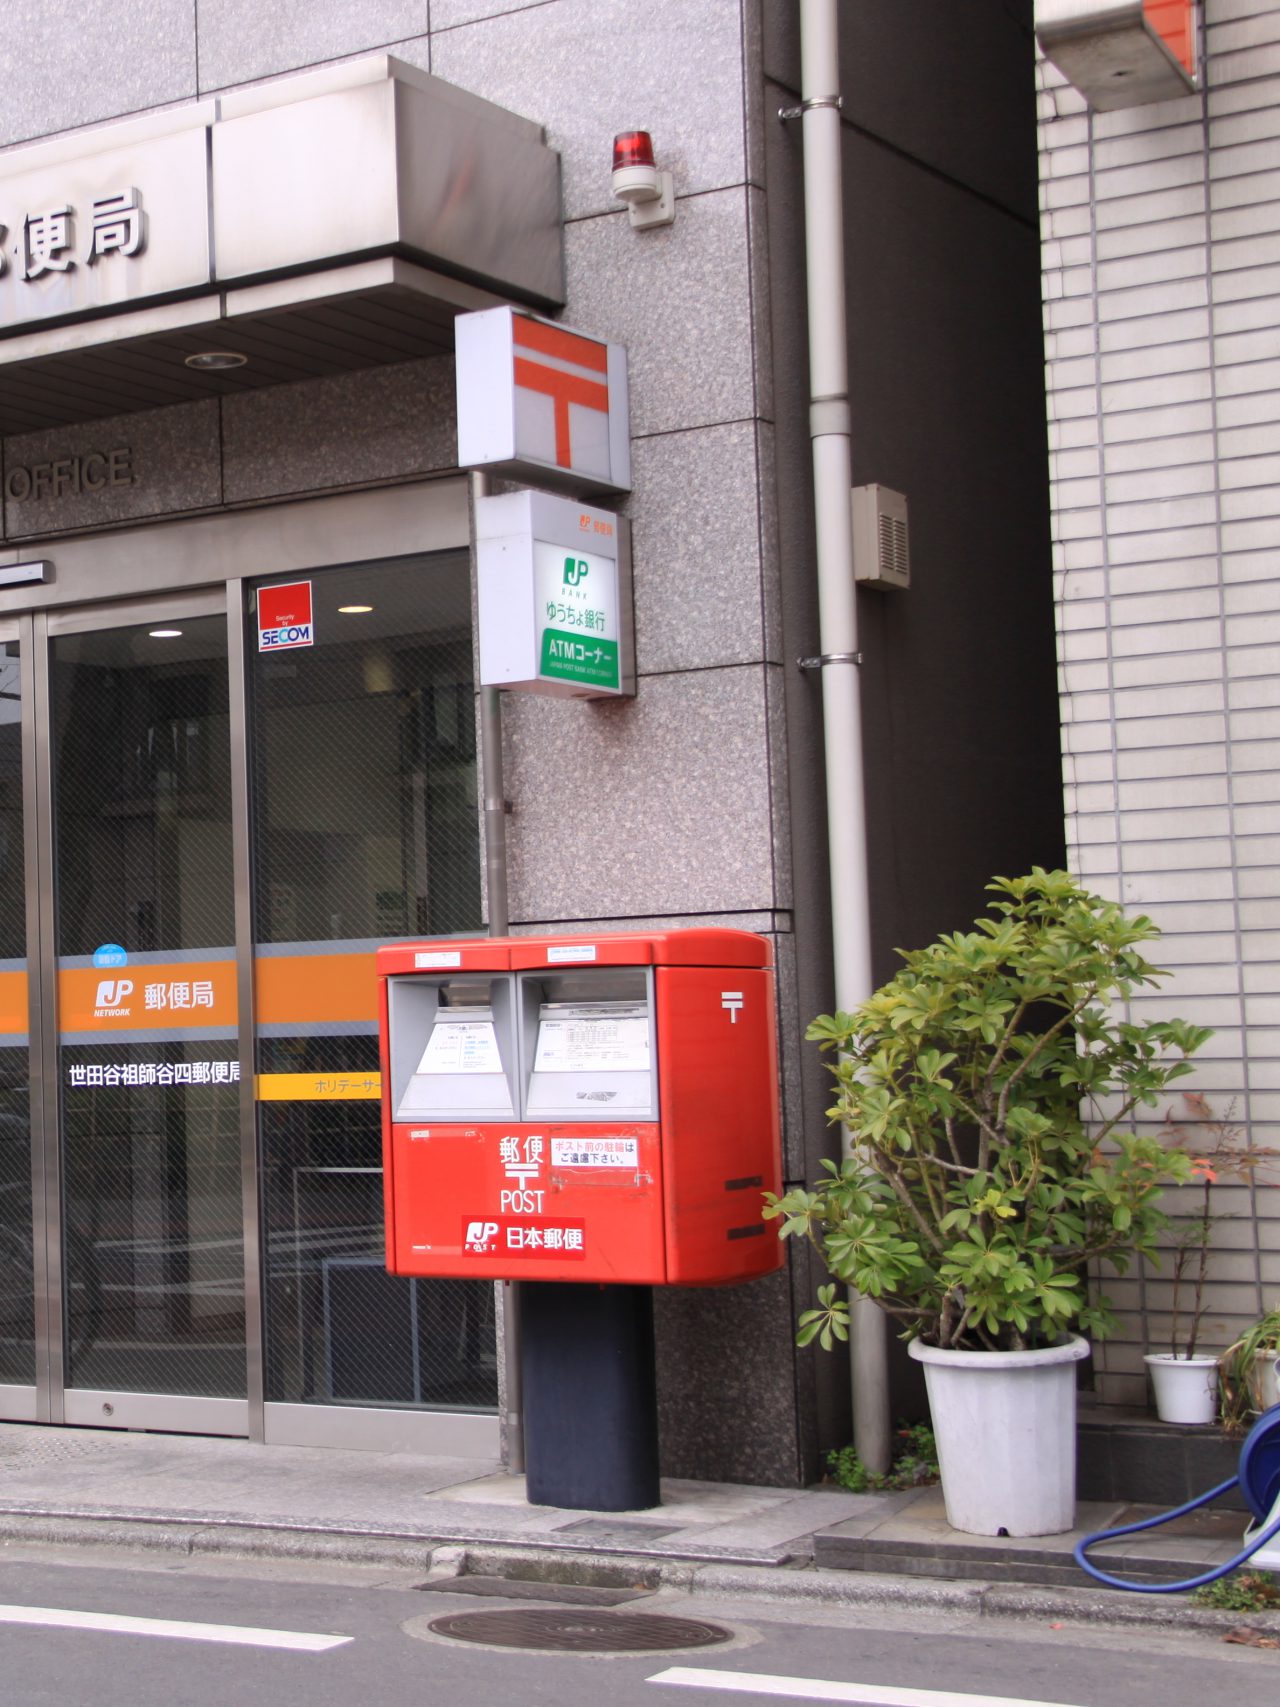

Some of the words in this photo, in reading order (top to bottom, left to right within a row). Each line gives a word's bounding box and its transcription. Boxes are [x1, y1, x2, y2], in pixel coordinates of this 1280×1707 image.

[5, 448, 132, 501] OFFICE
[563, 557, 588, 586] JP
[562, 588, 587, 599] BANK
[275, 614, 295, 622] Security
[546, 601, 605, 632] ゆうちょ銀行
[262, 626, 309, 646] SECOM
[549, 639, 612, 665] ATMコーナー
[95, 979, 133, 1008] JP
[144, 981, 214, 1010] 郵便局
[93, 1008, 131, 1017] NETWORK
[69, 1060, 240, 1087] 世田谷祖師谷四郵便局
[499, 1136, 544, 1164] 郵便
[555, 1141, 634, 1153] ポスト前の駐輪は
[500, 1189, 545, 1214] POST
[465, 1222, 499, 1243] JP
[506, 1227, 583, 1250] 日本郵便
